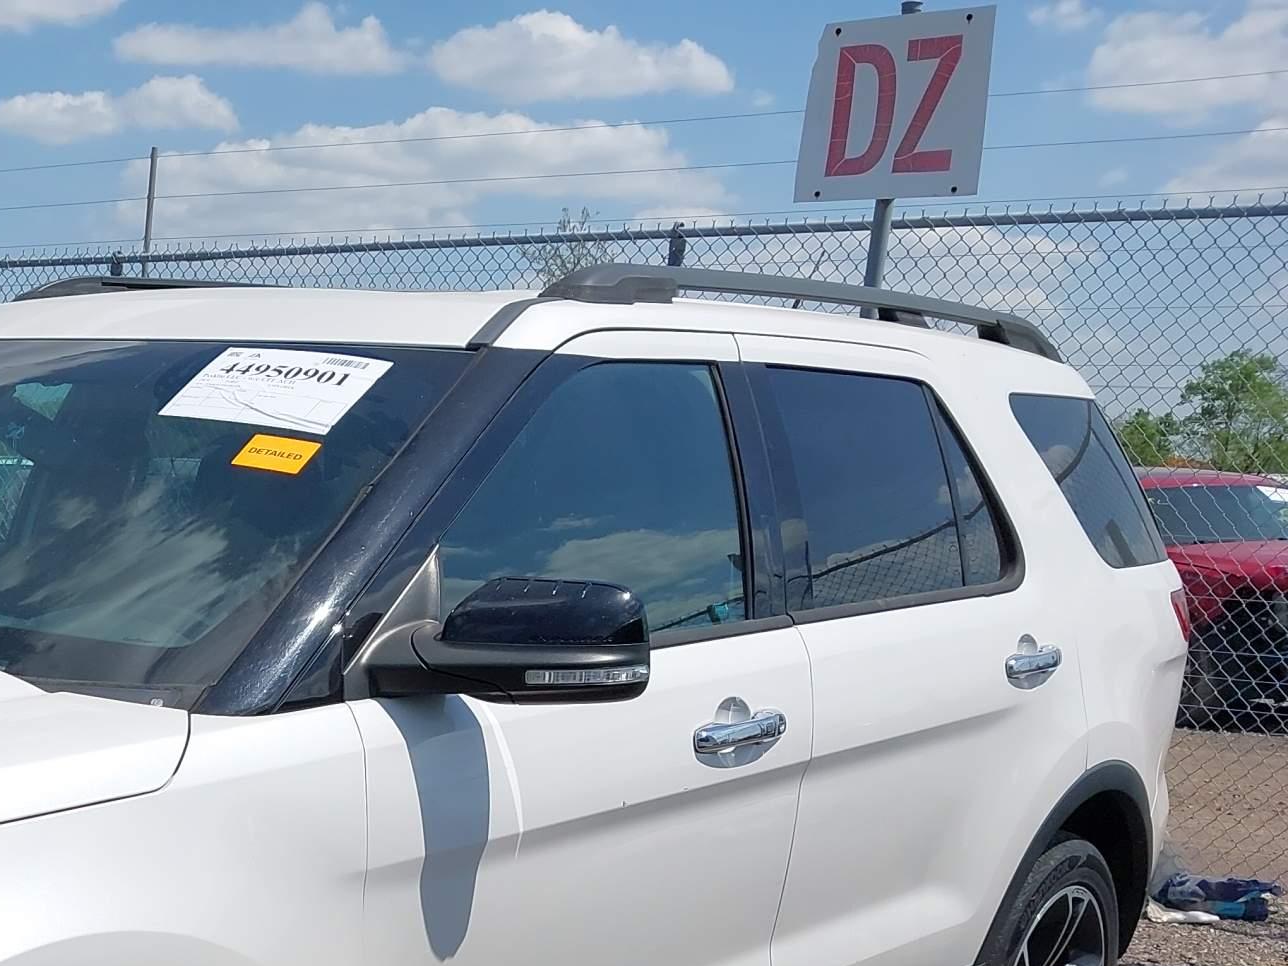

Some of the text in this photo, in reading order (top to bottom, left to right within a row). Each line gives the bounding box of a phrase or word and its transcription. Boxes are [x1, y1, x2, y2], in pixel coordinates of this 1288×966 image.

[824, 34, 963, 177] DZ
[219, 361, 351, 387] 44950901
[247, 446, 303, 461] DETAILED
